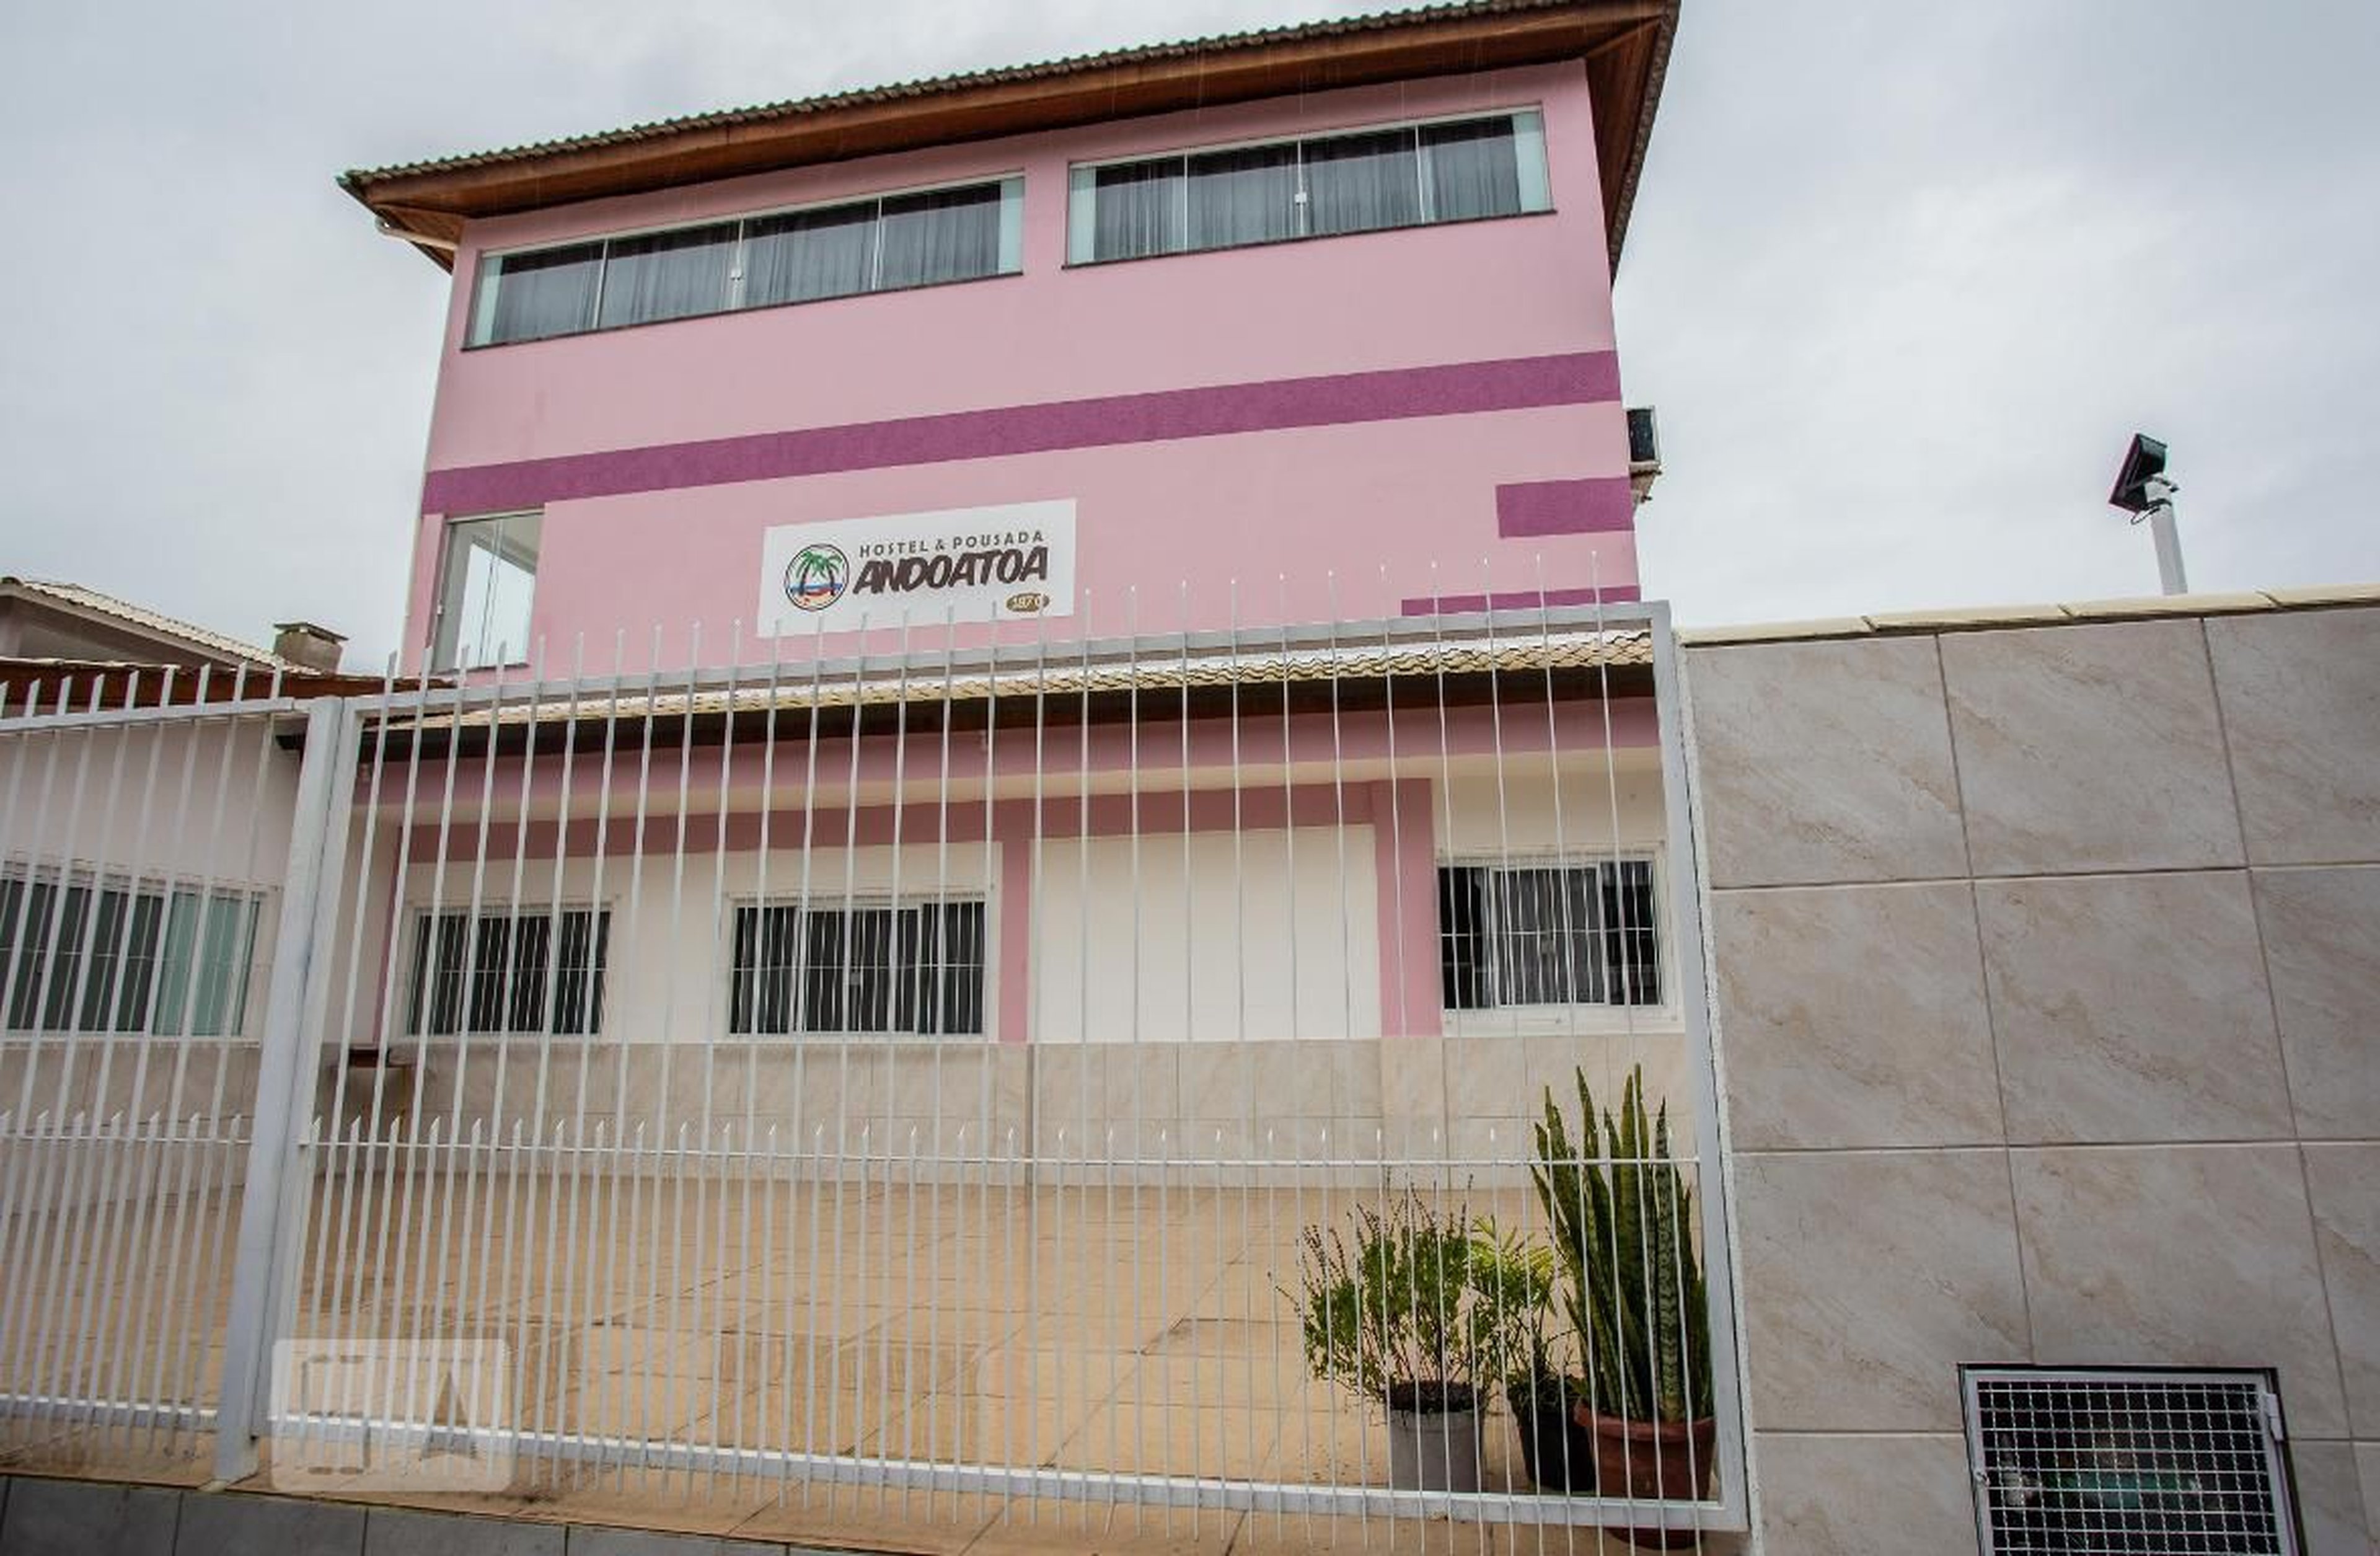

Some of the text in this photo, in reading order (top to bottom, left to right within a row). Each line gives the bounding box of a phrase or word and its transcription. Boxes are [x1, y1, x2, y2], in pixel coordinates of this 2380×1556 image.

[860, 530, 1044, 557] HOSTEL & POUSADA
[853, 546, 1048, 595] ANDOATOA
